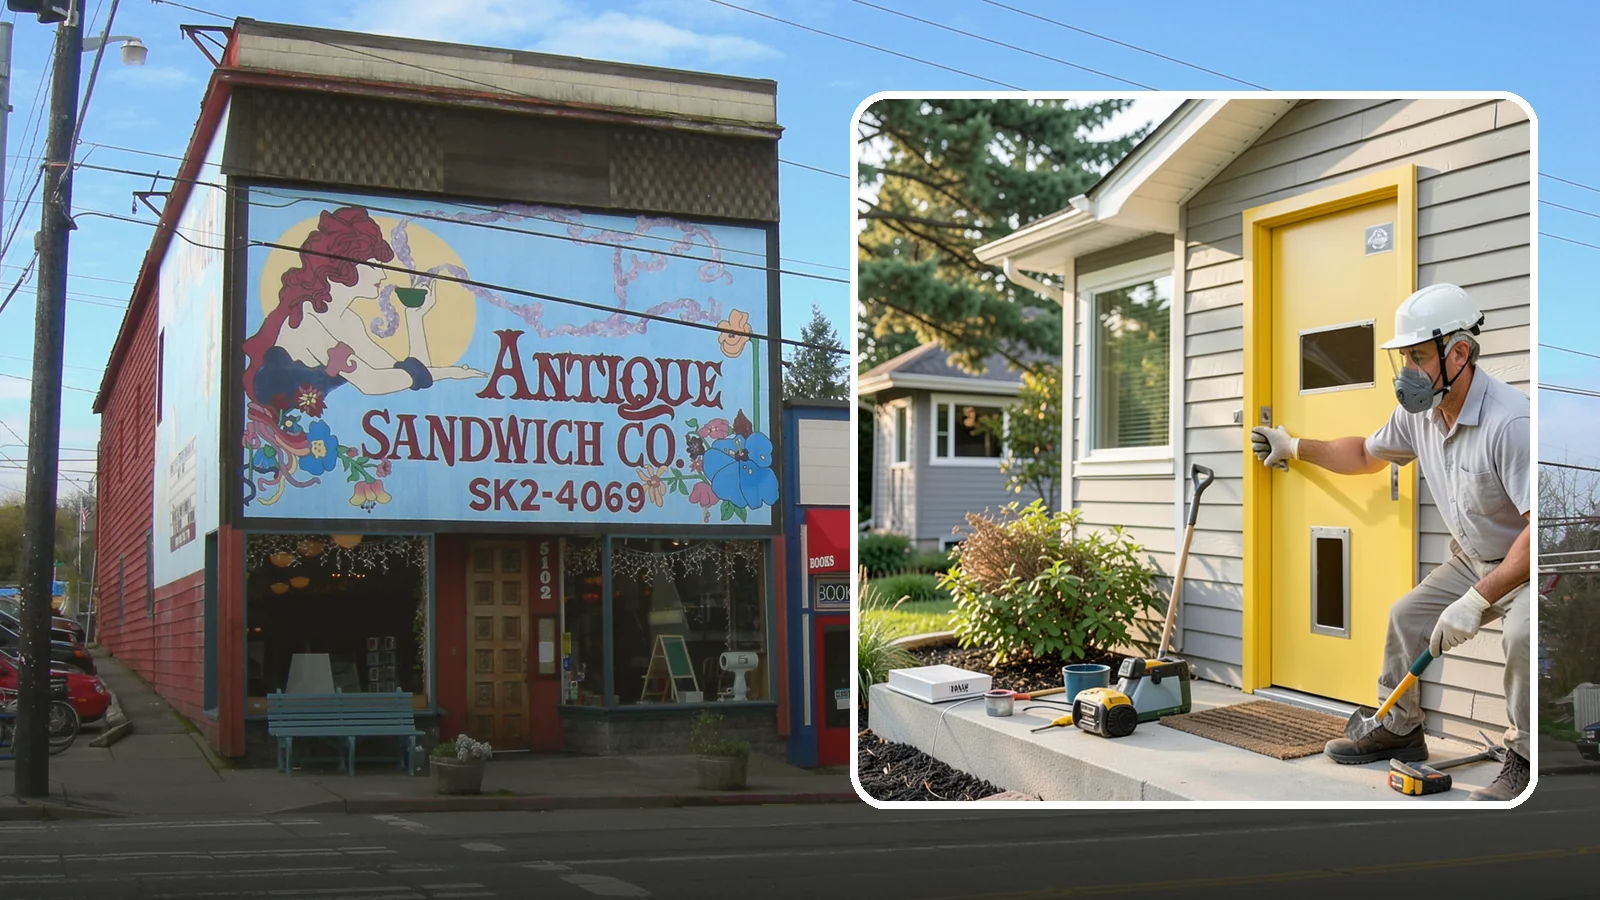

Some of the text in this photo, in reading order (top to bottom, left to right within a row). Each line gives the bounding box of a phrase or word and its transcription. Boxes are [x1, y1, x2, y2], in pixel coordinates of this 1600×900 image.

[475, 328, 723, 421] ANTIQUE
[361, 408, 685, 468] SANDWICH CO.
[469, 477, 645, 512] SK2-4069
[809, 554, 836, 570] BOOKS
